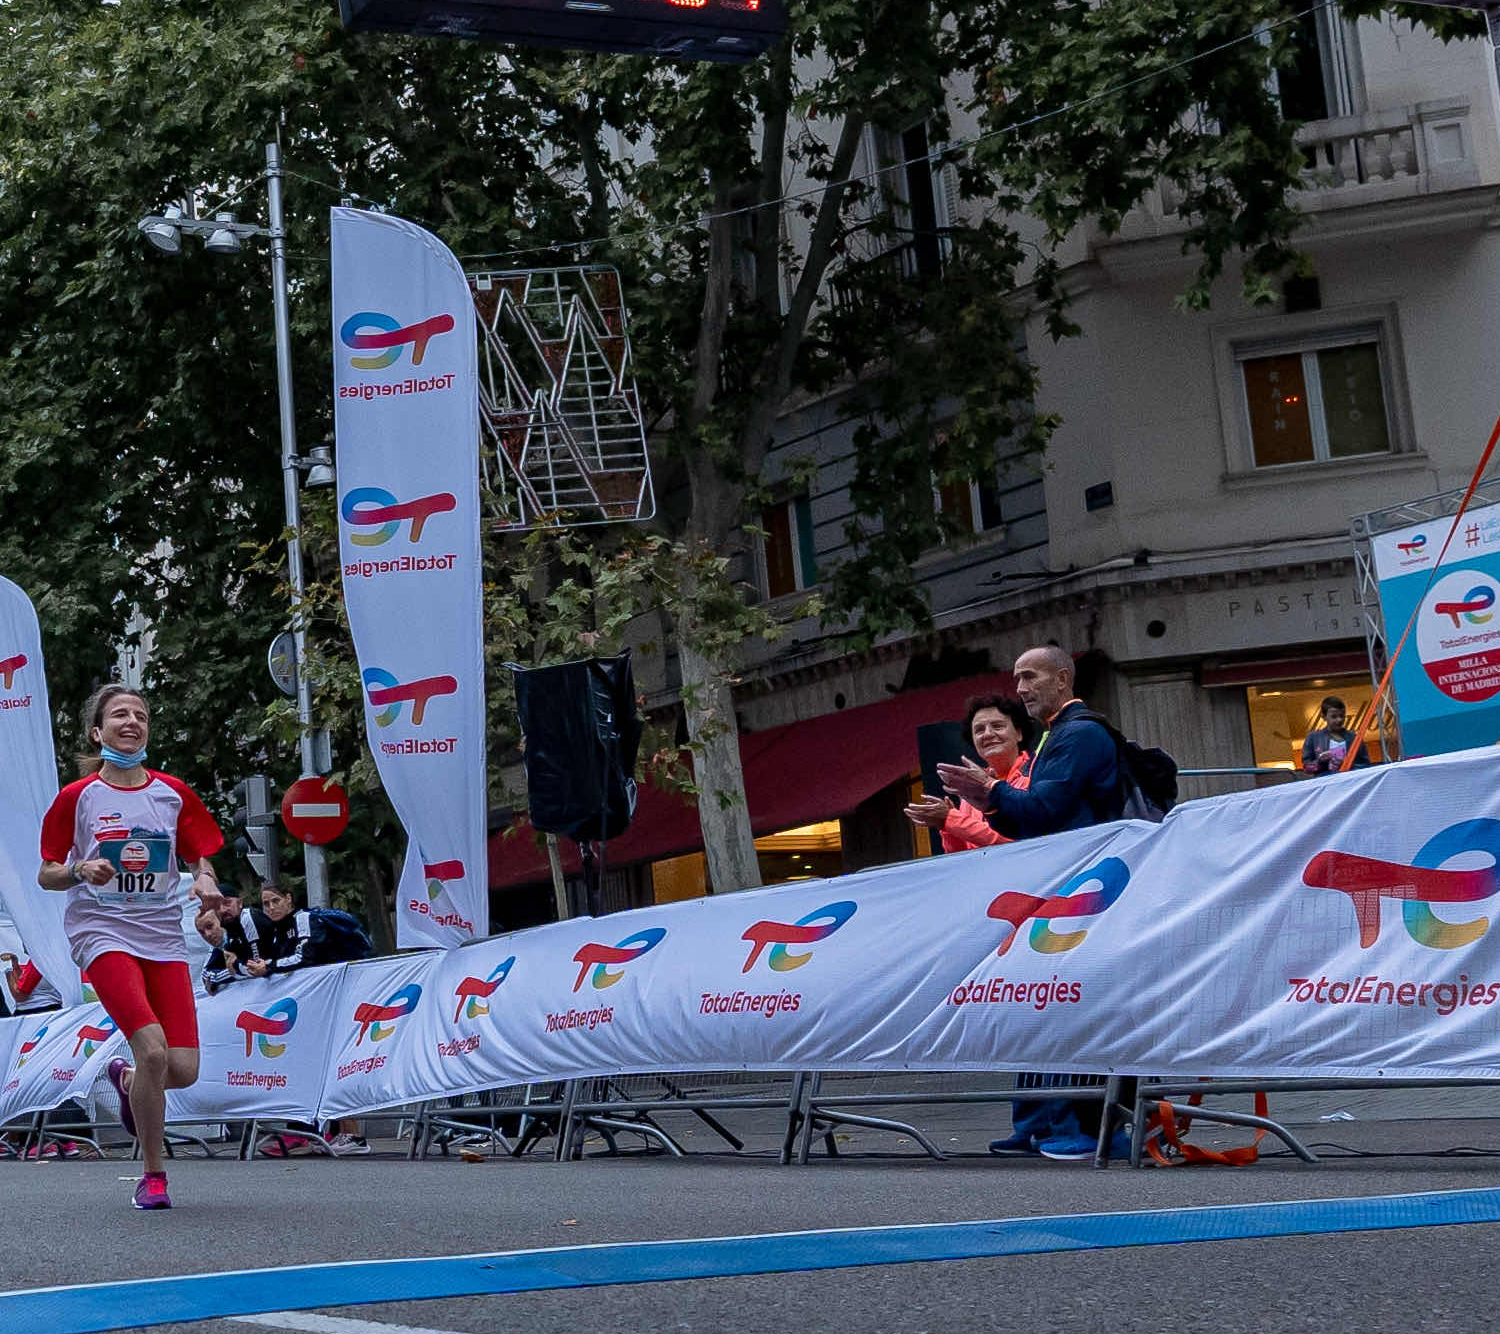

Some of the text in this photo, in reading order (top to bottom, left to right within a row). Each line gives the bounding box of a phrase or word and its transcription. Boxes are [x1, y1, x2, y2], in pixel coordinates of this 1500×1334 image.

[1451, 683, 1466, 694] DE
[115, 873, 155, 892] 1012
[700, 989, 801, 1018] TotalEnergies
[545, 1004, 613, 1034] TotalEnergies
[227, 1070, 287, 1091] TotalEnergies
